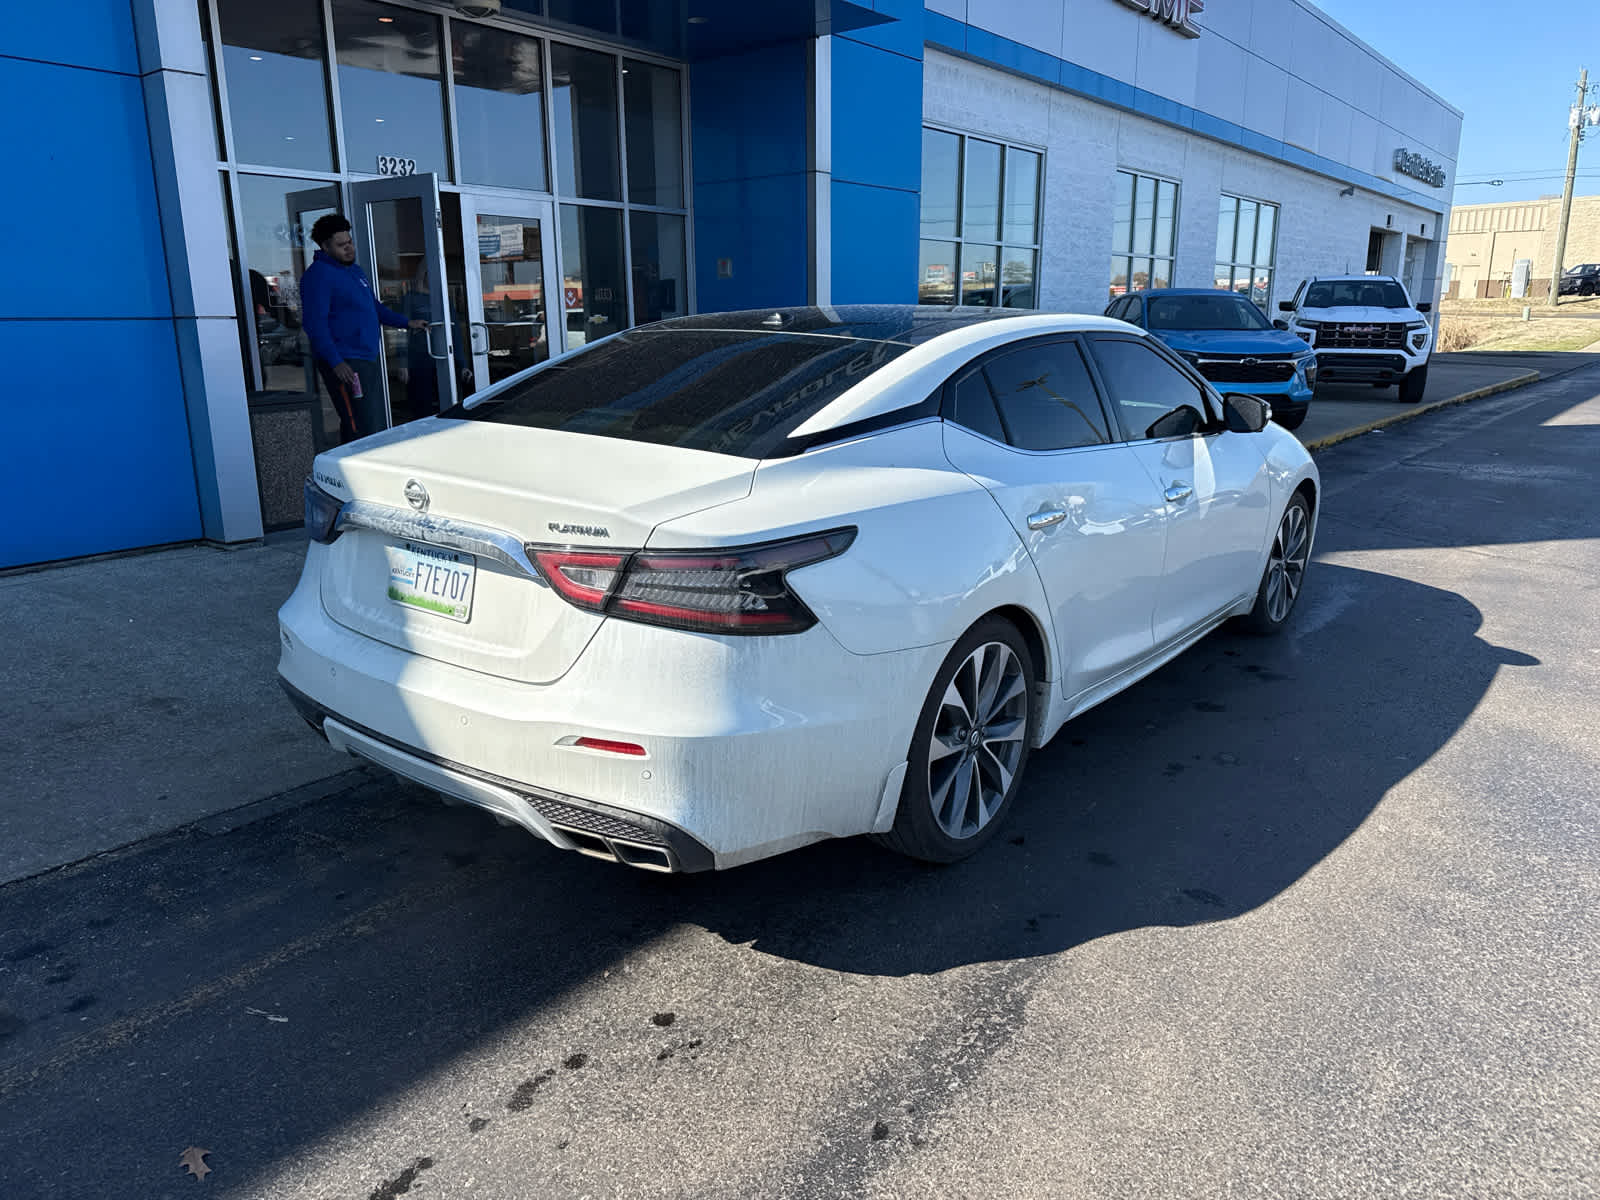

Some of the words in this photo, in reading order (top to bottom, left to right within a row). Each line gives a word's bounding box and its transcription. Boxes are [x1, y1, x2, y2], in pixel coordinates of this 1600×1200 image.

[1114, 0, 1204, 38] MC
[379, 156, 416, 176] 3232
[548, 522, 610, 538] PLATINUM
[411, 545, 453, 562] KENTUCKY
[414, 561, 470, 602] F7E707
